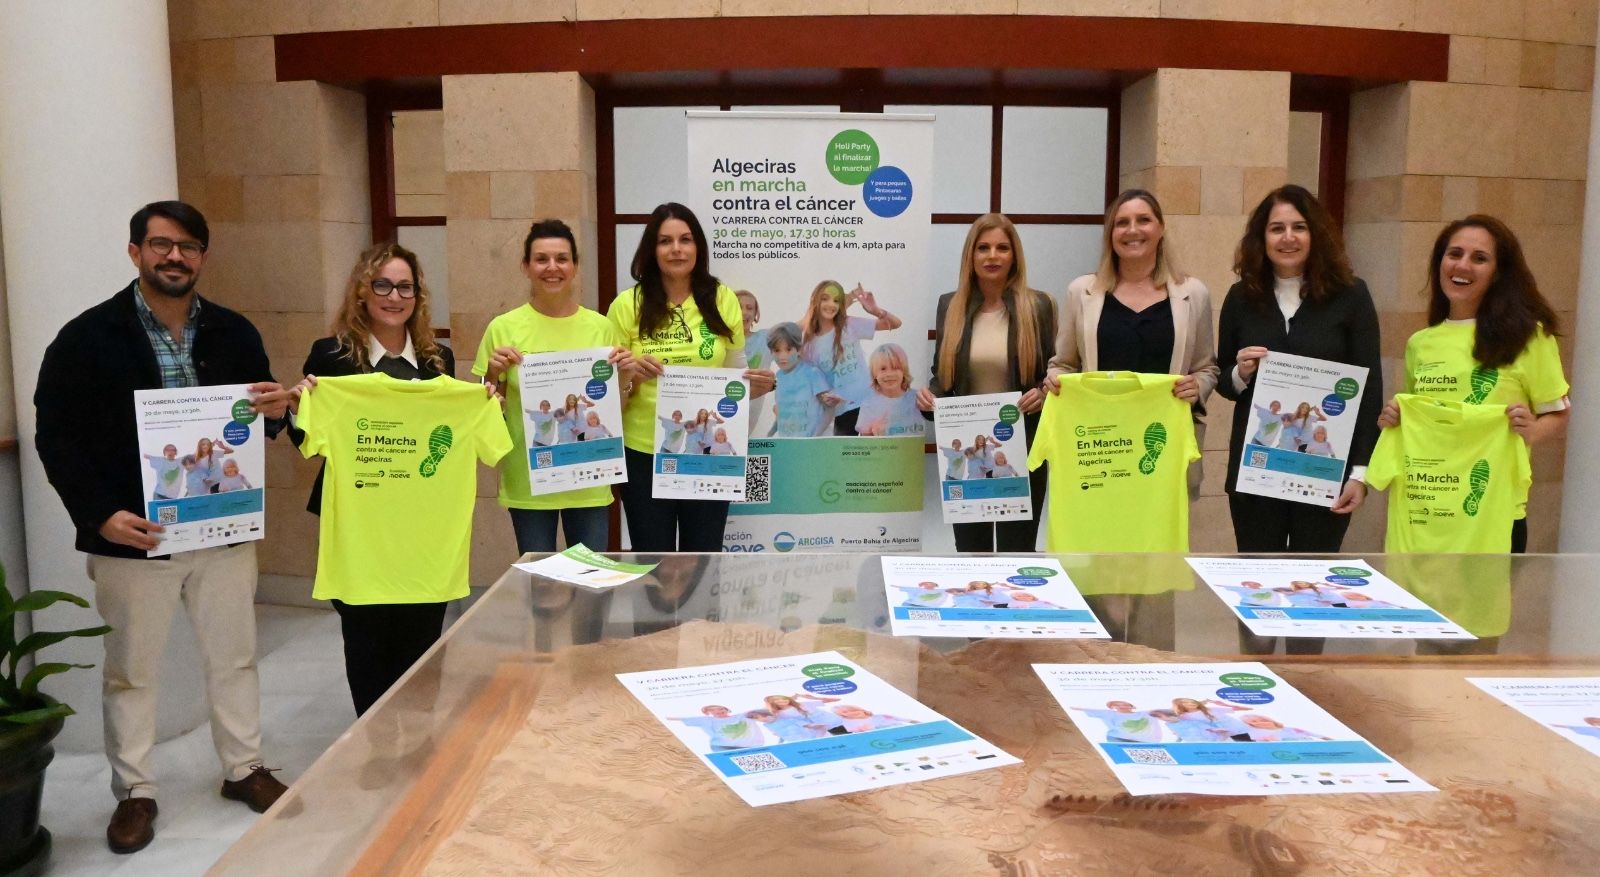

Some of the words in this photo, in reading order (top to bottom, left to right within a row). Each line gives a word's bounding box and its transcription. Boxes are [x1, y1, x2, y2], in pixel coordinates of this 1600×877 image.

[851, 143, 871, 152] Party
[712, 158, 796, 177] Algeciras
[712, 180, 736, 192] en
[740, 176, 806, 192] marcha
[712, 198, 770, 211] contra
[775, 196, 792, 210] el
[796, 196, 856, 211] cáncer
[712, 216, 720, 225] V
[721, 216, 767, 225] CARRERA
[769, 216, 809, 225] CONTRA
[812, 216, 823, 225] EL
[825, 215, 864, 225] CÁNCER
[713, 228, 728, 239] 30
[731, 227, 747, 238] de
[750, 229, 787, 240] mayo,
[790, 228, 820, 240] 17.30
[822, 227, 856, 238] horas
[713, 241, 747, 249] Marcha
[764, 240, 820, 251] competitiva
[822, 241, 833, 249] de
[843, 241, 860, 251] km,
[862, 242, 883, 251] apta
[885, 242, 906, 251] para
[758, 251, 800, 261] públicos.
[1419, 374, 1457, 384] Marcha
[358, 435, 371, 444] En
[375, 435, 416, 446] Marcha
[1077, 441, 1090, 449] En
[1093, 438, 1132, 448] Marcha
[1078, 458, 1112, 466] Algeciras
[1417, 472, 1459, 483] Marcha
[798, 537, 834, 546] ARCGISA
[646, 674, 696, 683] CARRERA
